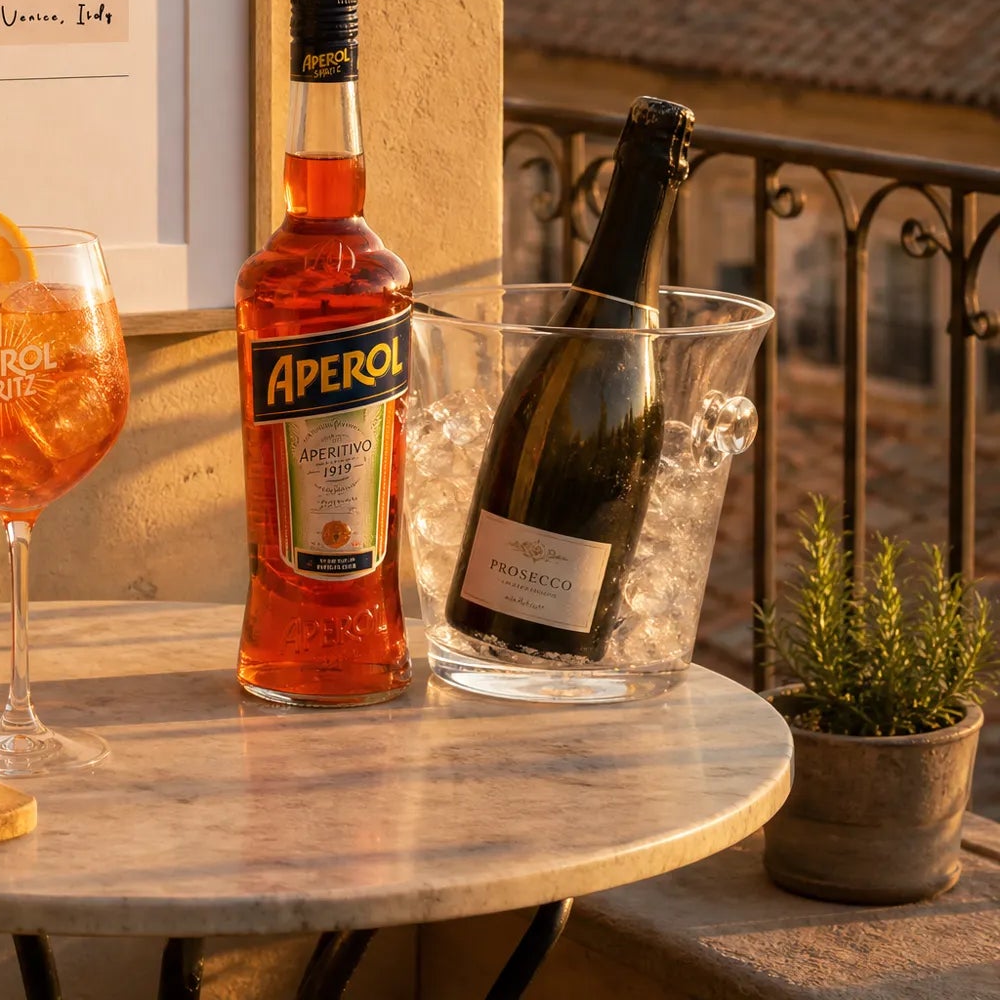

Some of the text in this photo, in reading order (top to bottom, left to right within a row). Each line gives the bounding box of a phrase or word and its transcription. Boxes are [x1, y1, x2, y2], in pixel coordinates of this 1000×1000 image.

[302, 47, 351, 73] APEROL
[267, 336, 403, 405] APEROL
[300, 439, 372, 463] APERITIVO
[324, 463, 352, 478] 1919
[489, 558, 573, 593] PROSECCO
